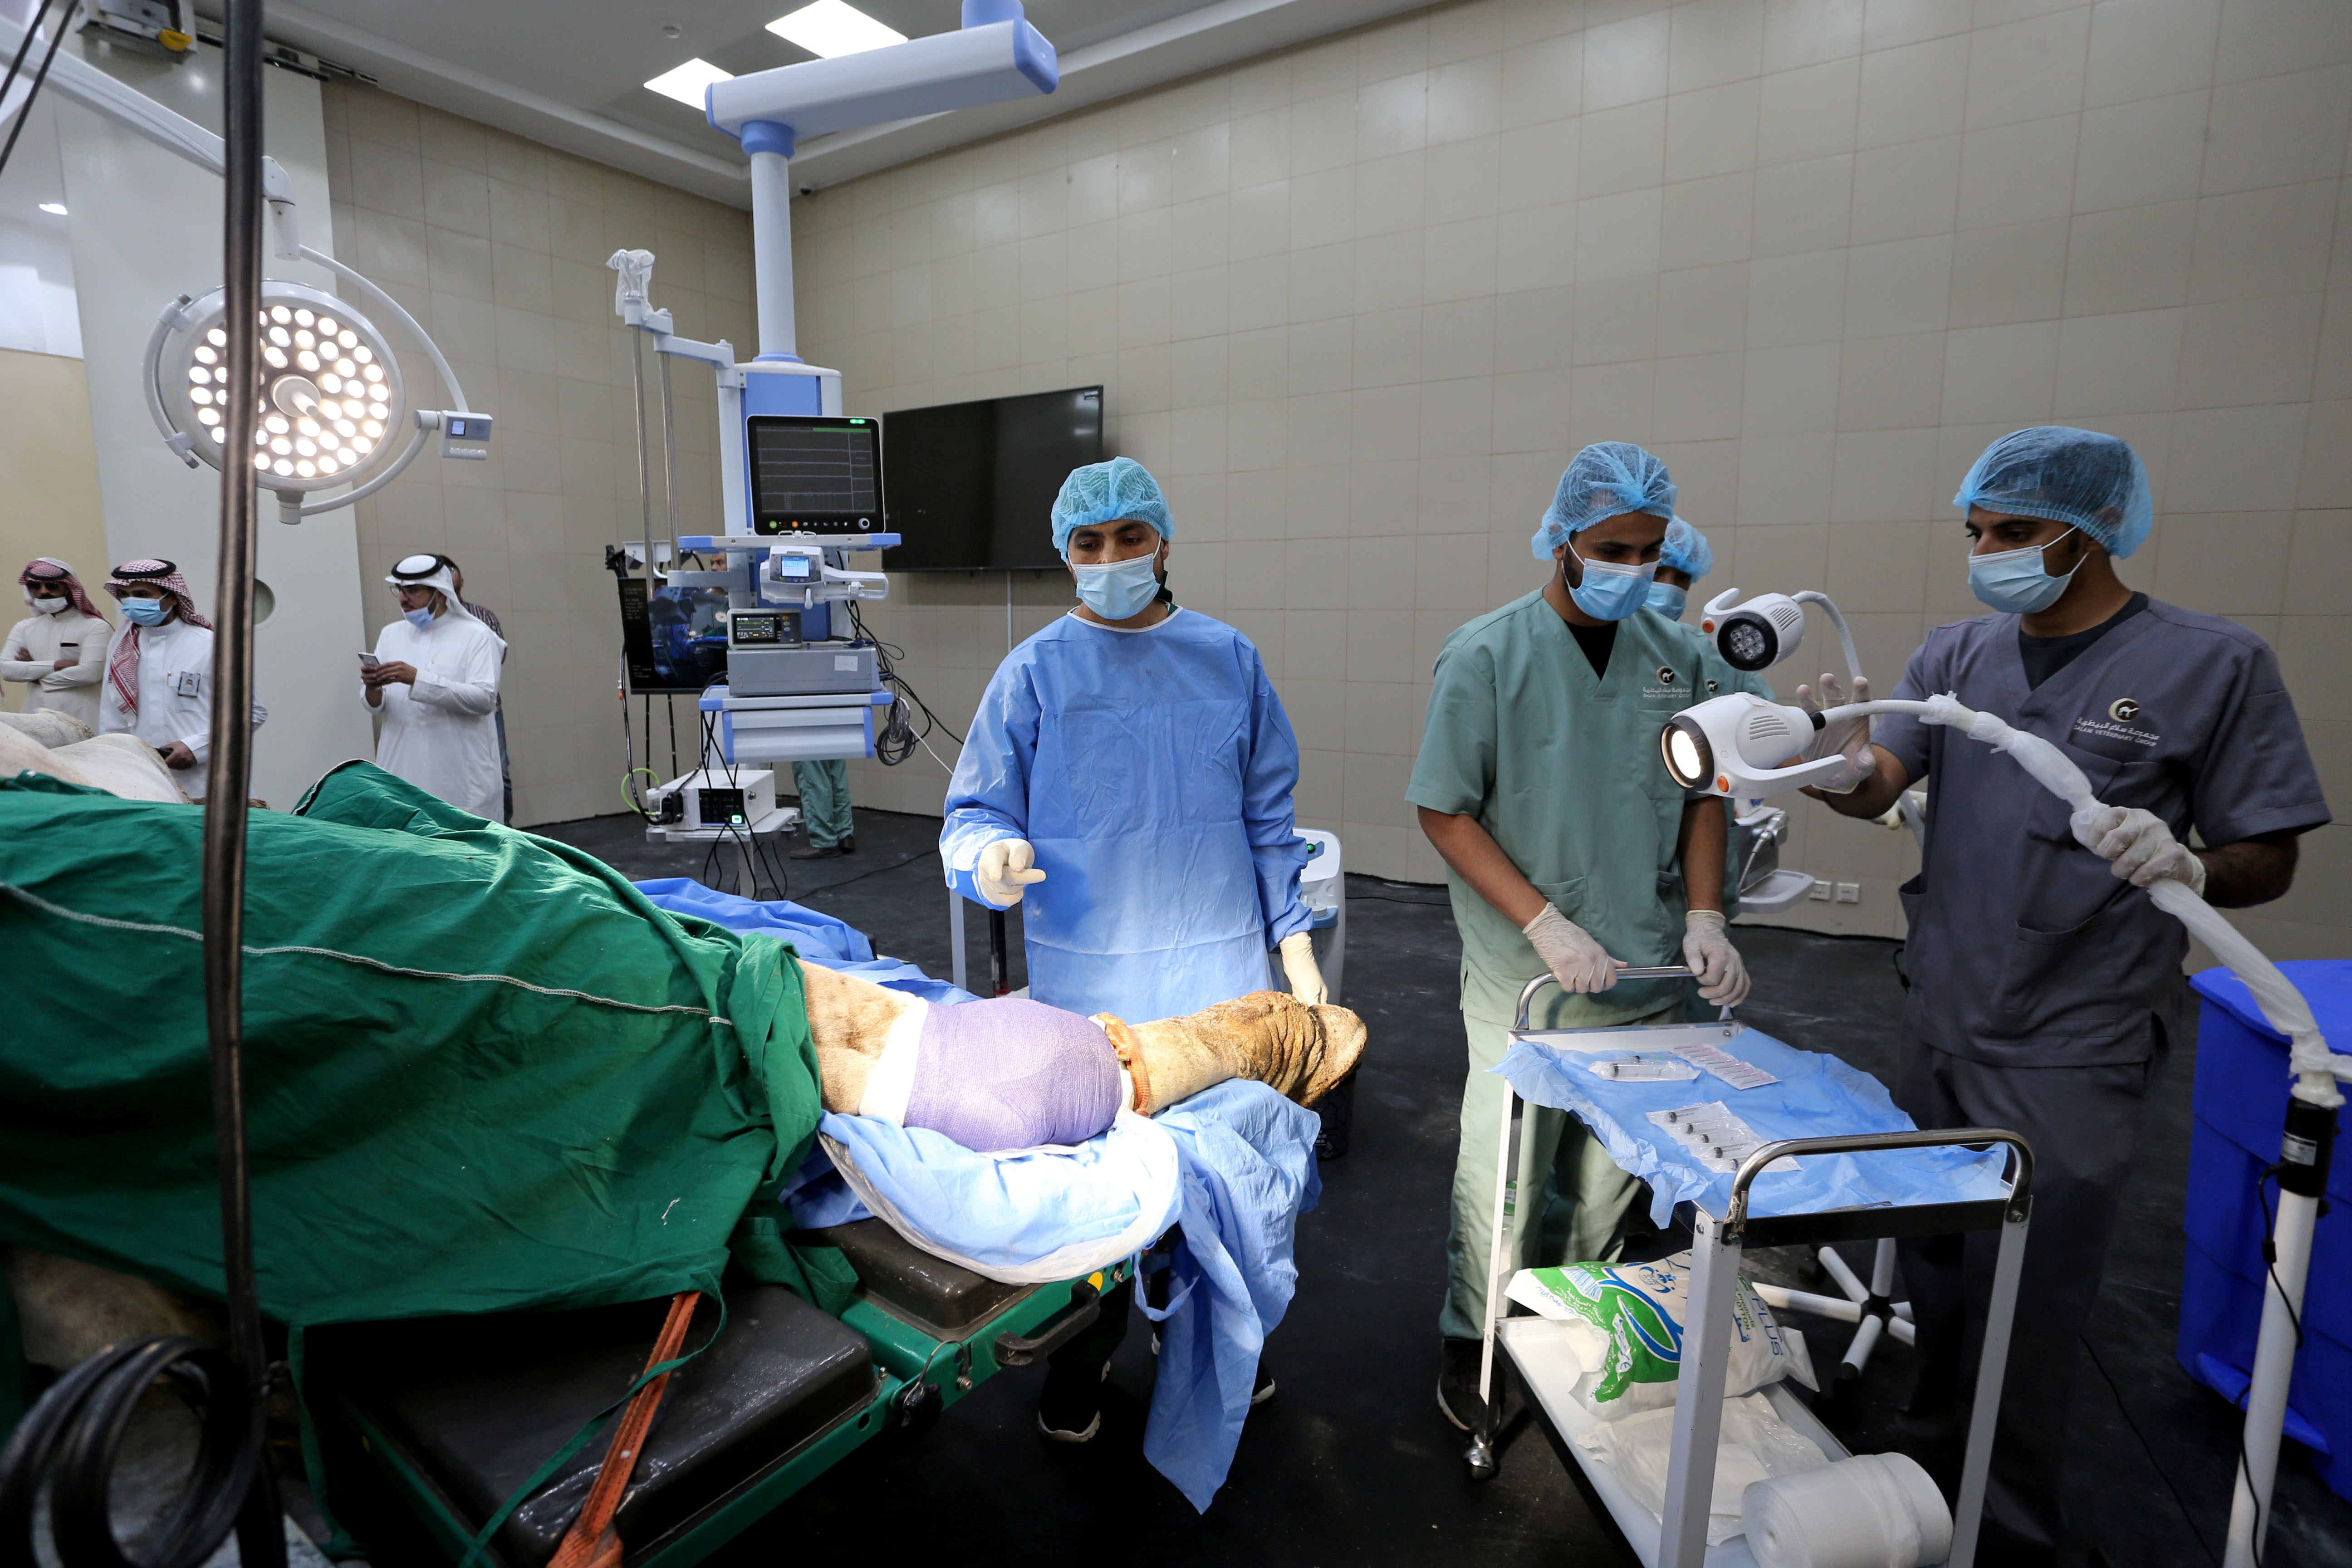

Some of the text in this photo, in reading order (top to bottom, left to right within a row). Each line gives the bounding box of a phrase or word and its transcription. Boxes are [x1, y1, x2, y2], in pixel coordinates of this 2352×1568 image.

[2073, 725, 2157, 747] SALAM VETERINARY GROUP
[2128, 727, 2160, 740] مجموعة
[1751, 1298, 1783, 1355] PLUS
